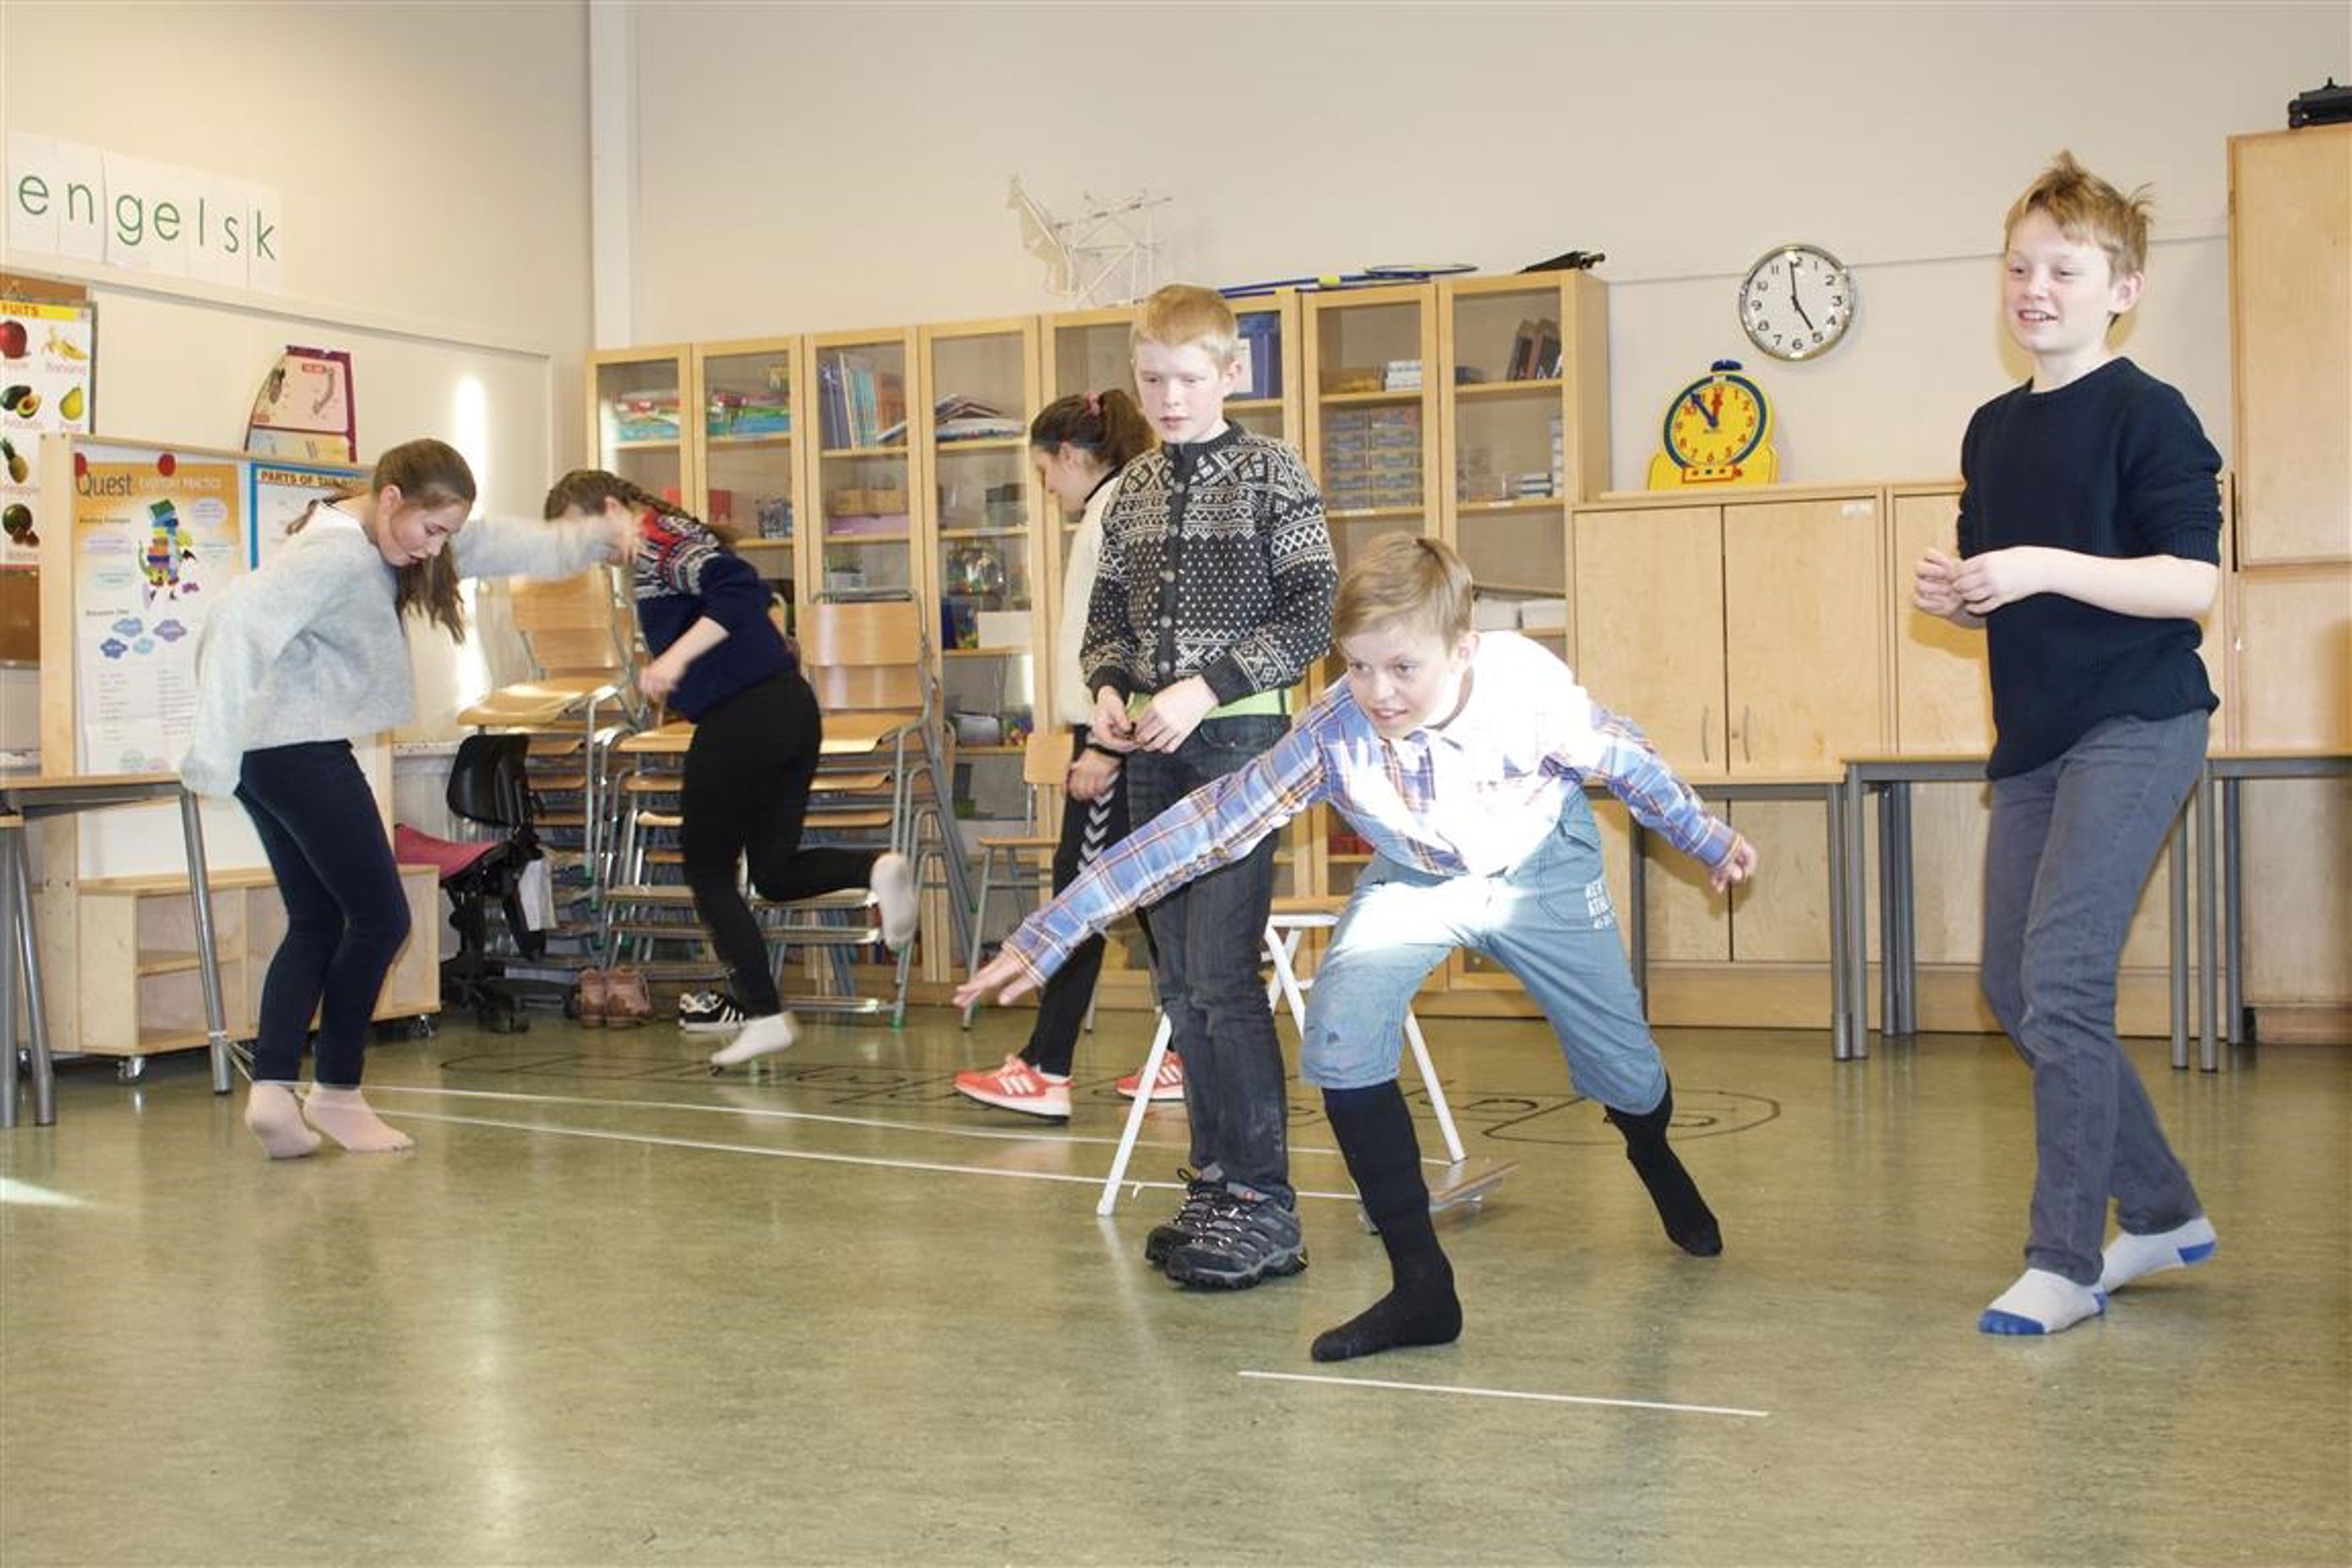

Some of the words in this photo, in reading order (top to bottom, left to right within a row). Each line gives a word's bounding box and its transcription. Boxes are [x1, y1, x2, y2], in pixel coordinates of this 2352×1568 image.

[18, 174, 275, 262] engelsk
[1825, 274, 1836, 286] 2
[1832, 295, 1843, 308] 3
[1772, 333, 1783, 346] 7
[1791, 338, 1804, 350] 6
[75, 472, 133, 497] Quest
[260, 470, 297, 485] PARTS
[299, 474, 313, 487] OF
